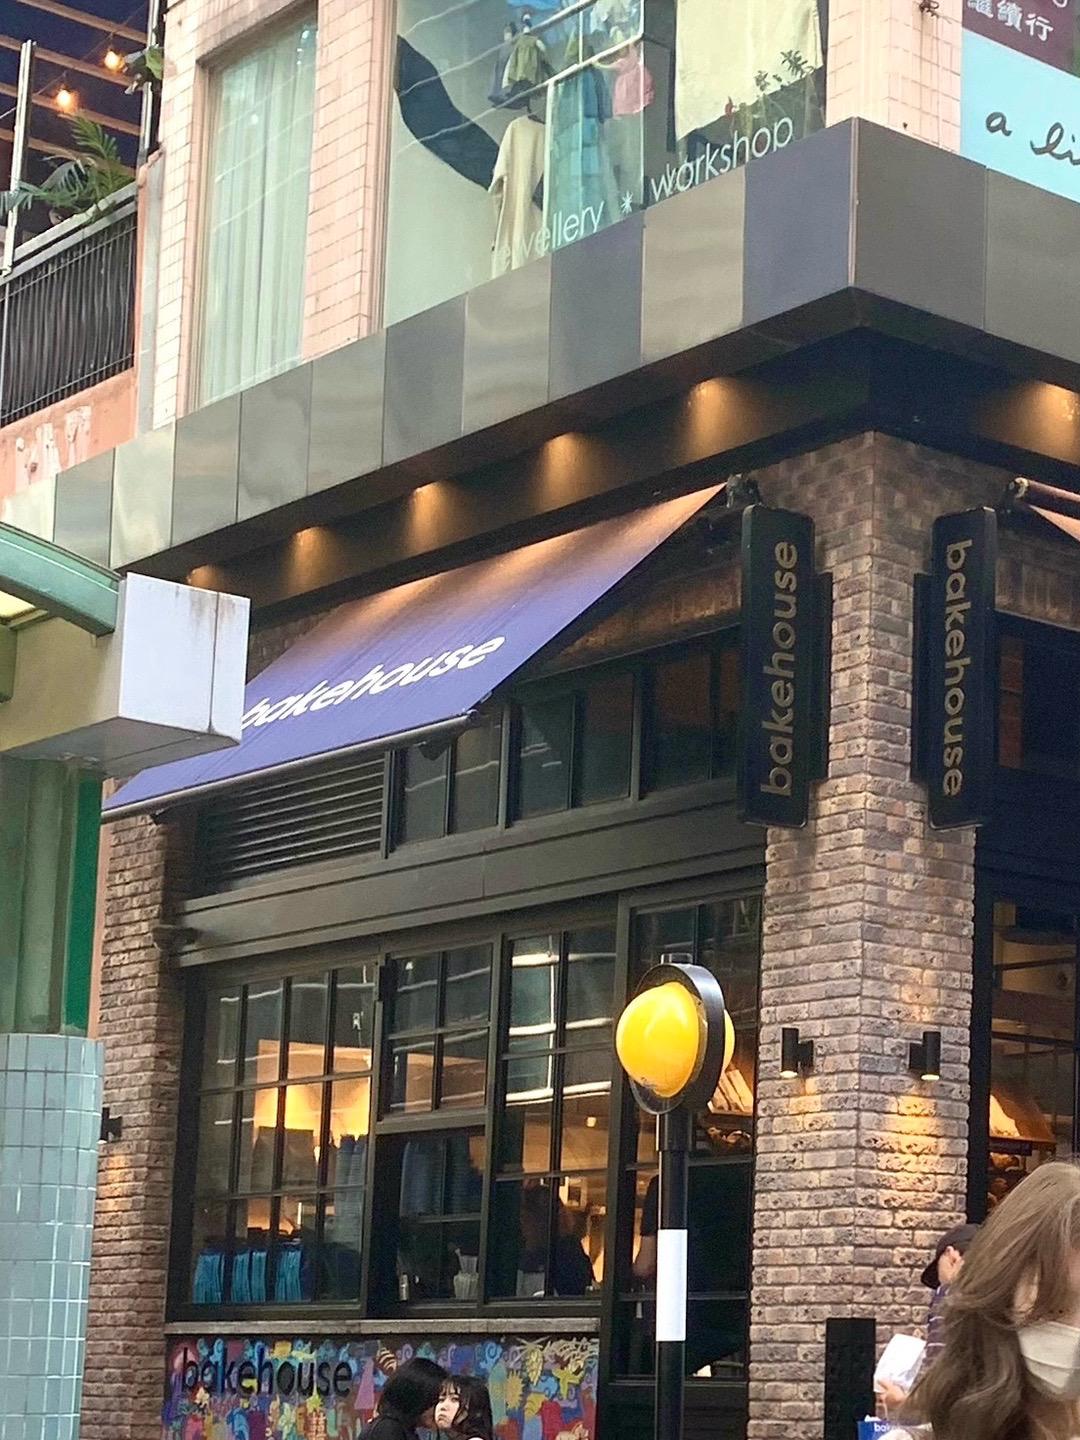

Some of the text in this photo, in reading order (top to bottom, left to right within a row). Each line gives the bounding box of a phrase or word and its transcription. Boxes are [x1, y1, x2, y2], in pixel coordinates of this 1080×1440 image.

[650, 116, 793, 202] workshop
[985, 111, 1012, 137] a
[241, 636, 505, 731] bakehouse
[760, 541, 798, 797] bakehouse
[942, 539, 973, 797] bakehouse
[181, 1347, 352, 1397] bakehouse
